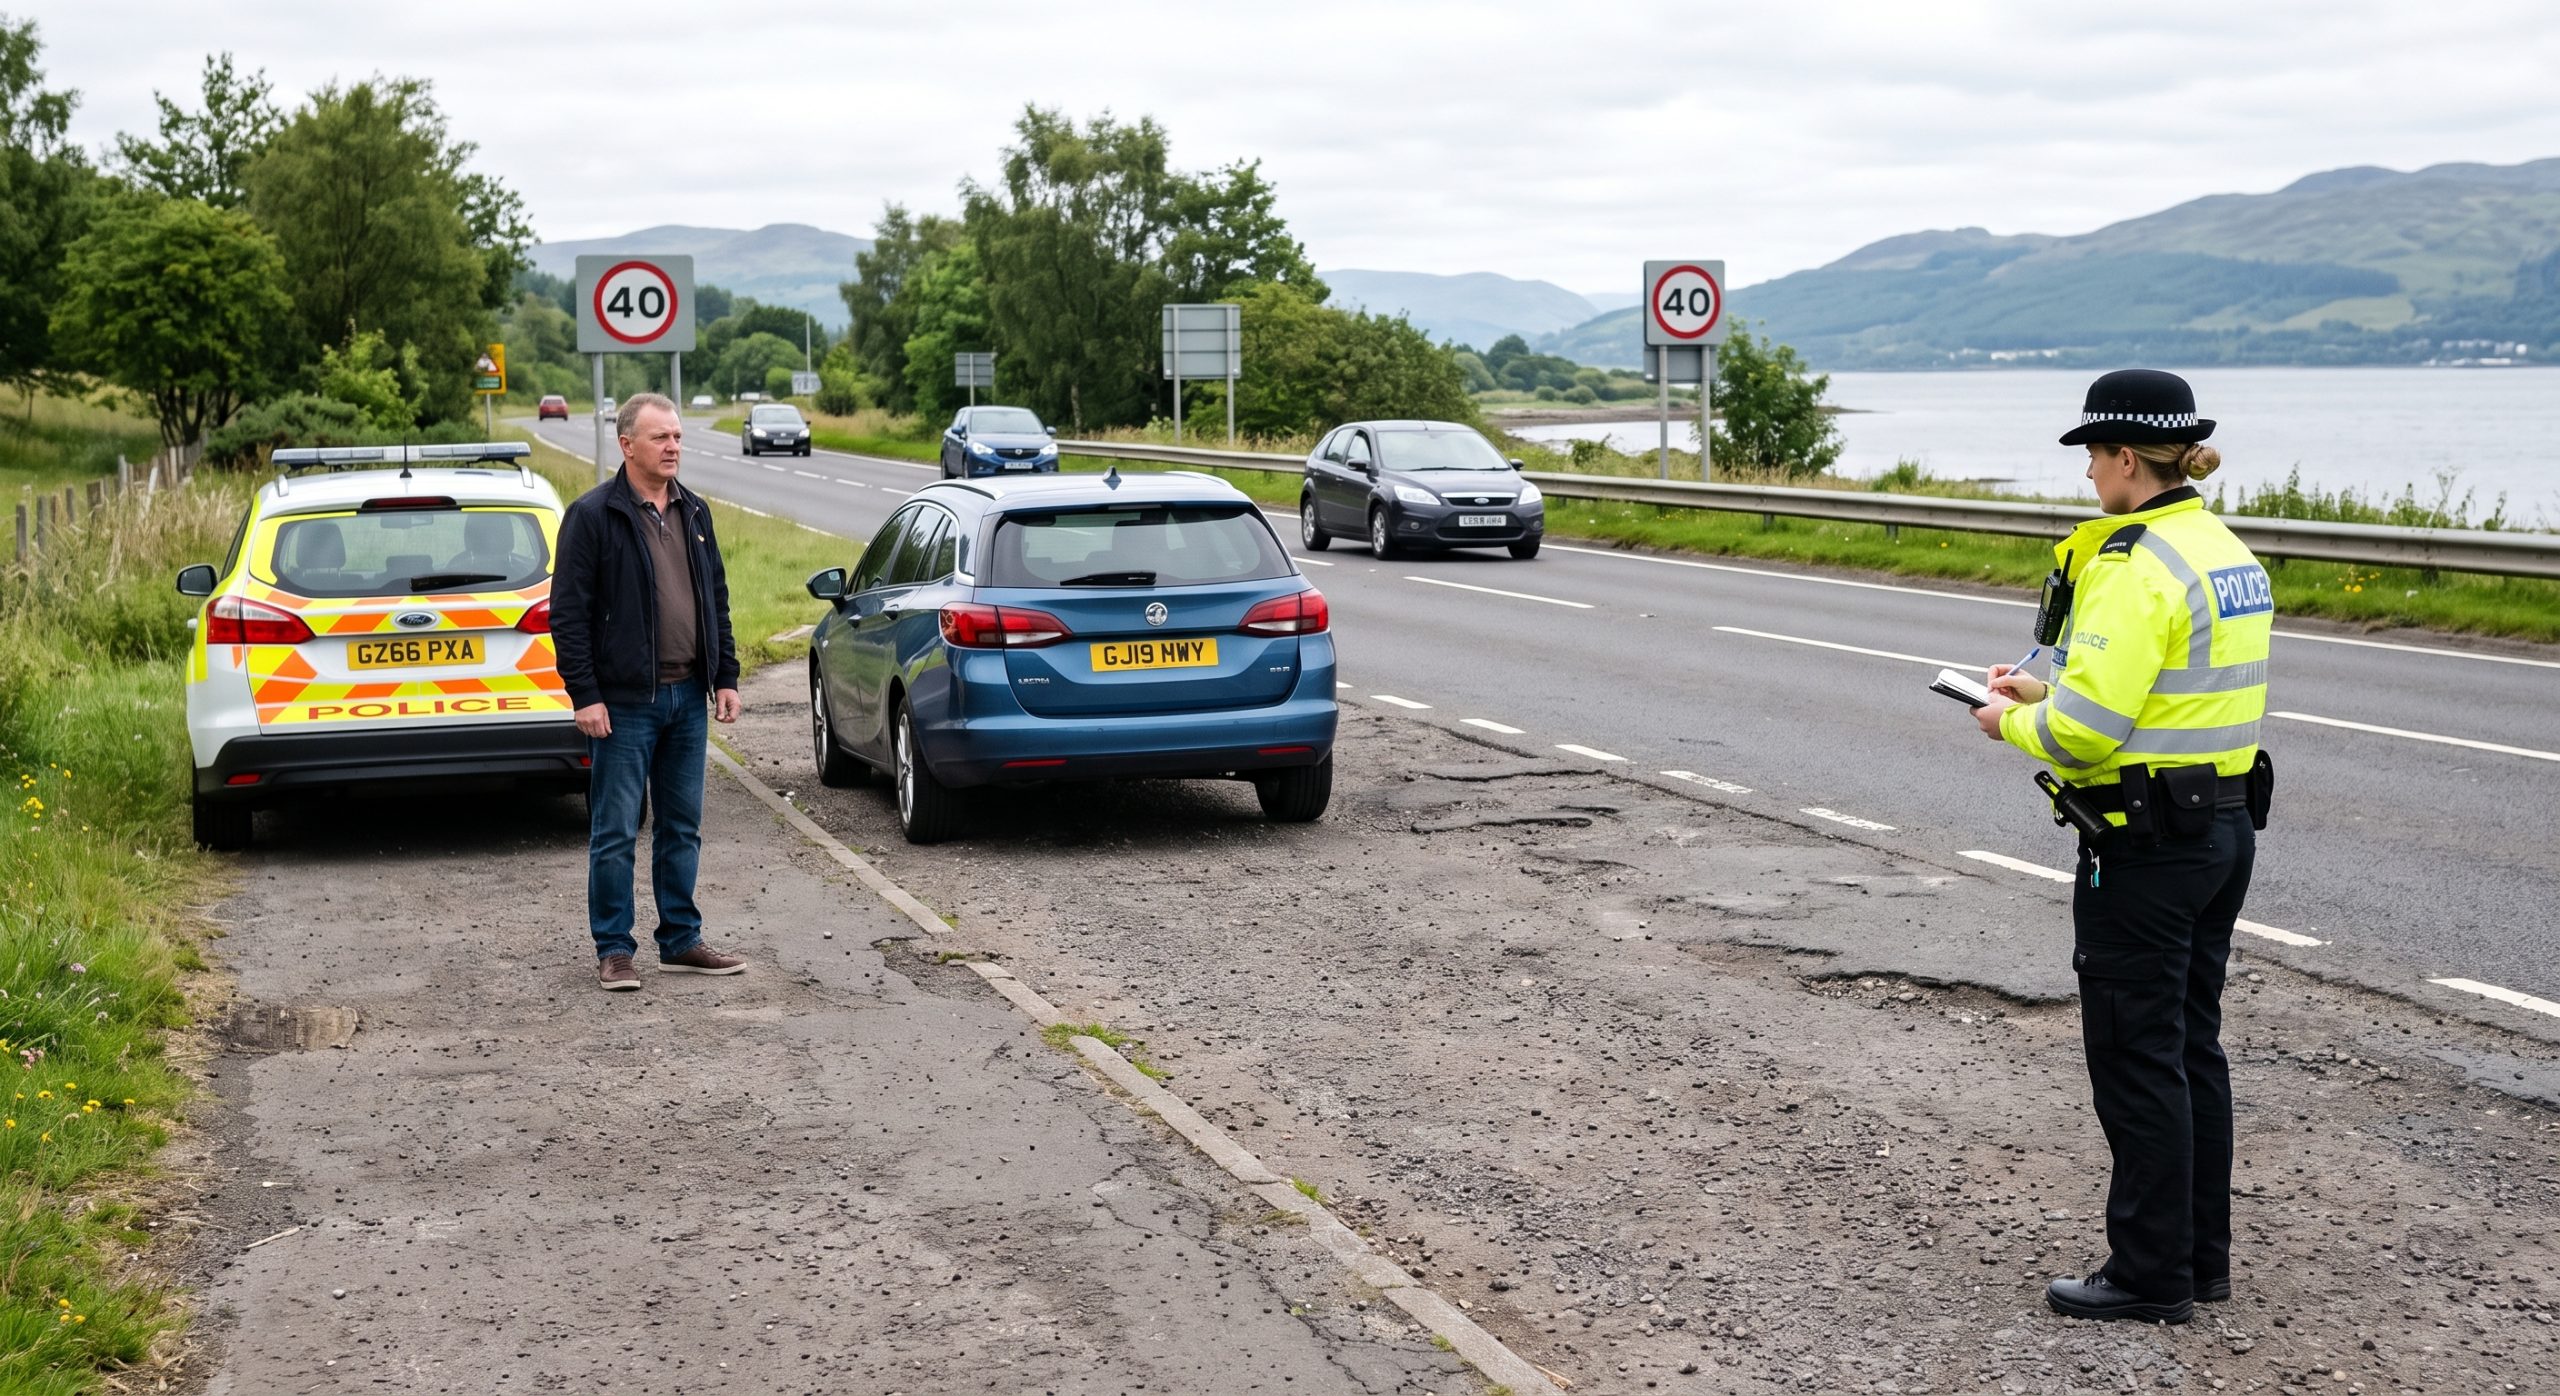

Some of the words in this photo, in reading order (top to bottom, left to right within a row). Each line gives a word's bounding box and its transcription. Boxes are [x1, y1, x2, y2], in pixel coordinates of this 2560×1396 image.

[607, 286, 665, 319] 40
[1663, 288, 1710, 317] 40
[2214, 571, 2270, 612] POLICE
[358, 641, 421, 664] GZ66
[428, 639, 475, 661] PXA
[1104, 643, 1154, 666] GJ19
[308, 697, 531, 720] POLICE
